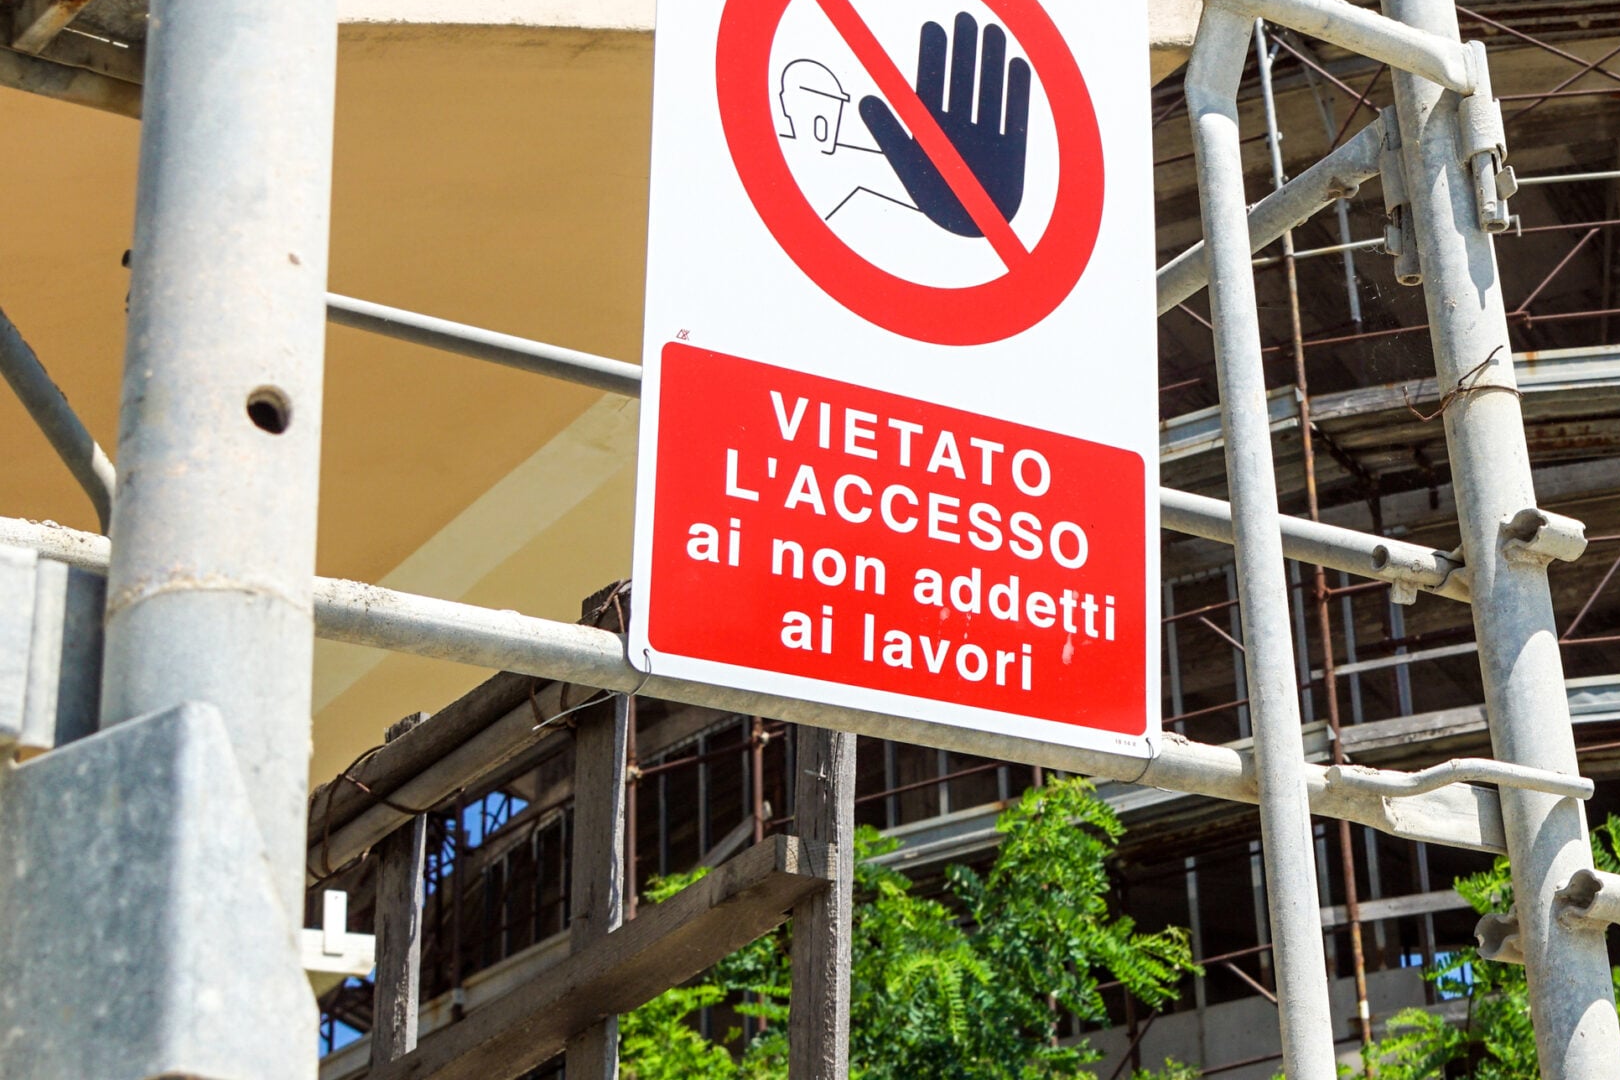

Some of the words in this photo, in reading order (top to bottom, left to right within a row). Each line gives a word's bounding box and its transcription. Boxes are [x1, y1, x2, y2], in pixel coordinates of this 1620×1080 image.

[769, 390, 1051, 497] VIETATO
[725, 448, 1089, 570] L'ACCESSO
[686, 517, 741, 567] ai
[771, 538, 886, 595] non
[913, 567, 1115, 641] addetti
[780, 604, 833, 654] ai
[863, 613, 1032, 691] lavori
